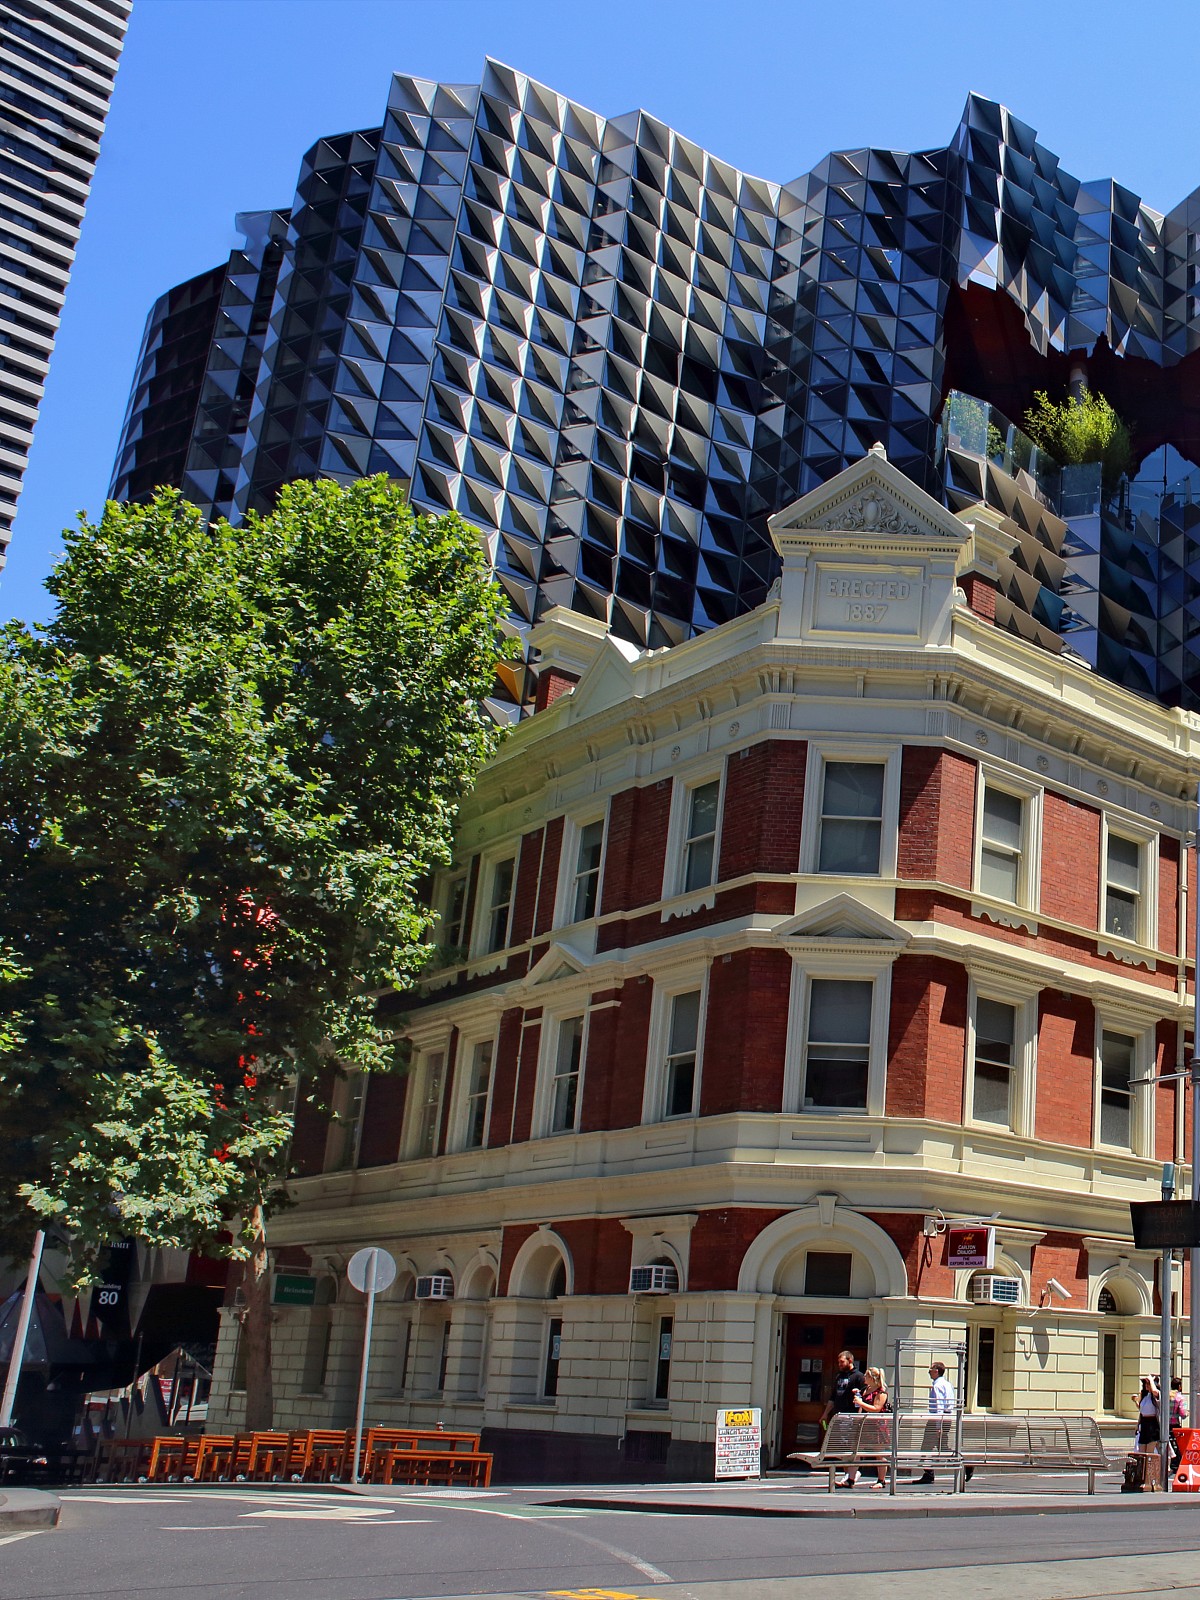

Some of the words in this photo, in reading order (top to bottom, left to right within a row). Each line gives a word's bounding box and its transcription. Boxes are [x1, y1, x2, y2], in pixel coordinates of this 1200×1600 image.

[826, 578, 911, 600] ERECTED
[845, 602, 889, 623] 1887
[98, 1291, 118, 1305] 80
[727, 1410, 750, 1422] FOX
